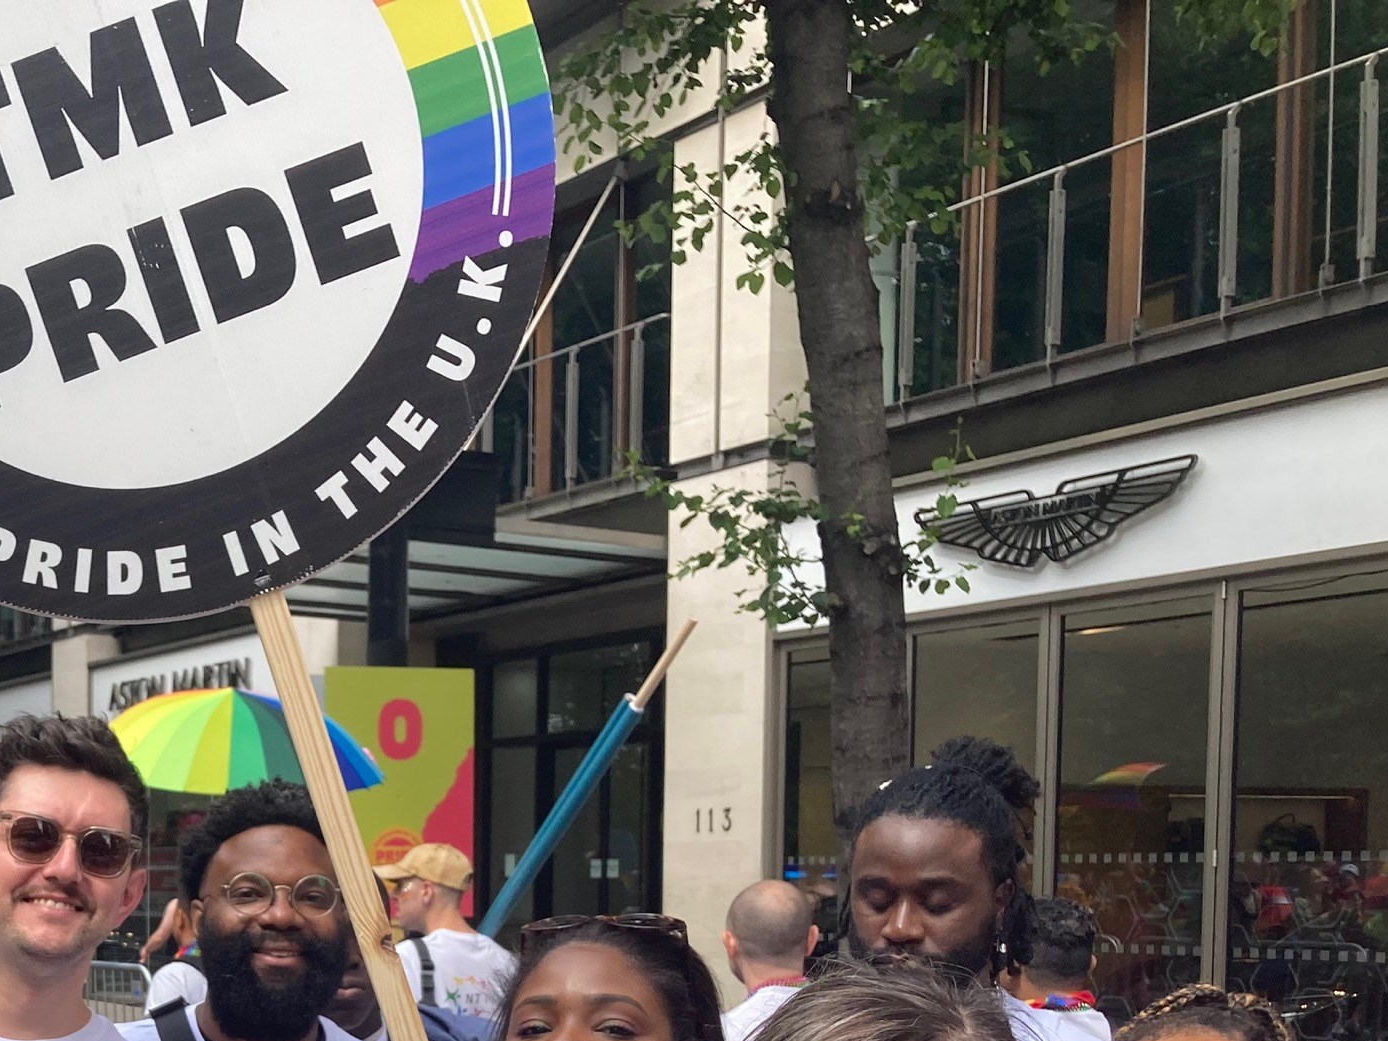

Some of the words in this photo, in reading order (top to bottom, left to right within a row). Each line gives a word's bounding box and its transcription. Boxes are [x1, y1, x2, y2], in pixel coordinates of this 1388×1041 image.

[222, 510, 301, 577] IN
[314, 400, 439, 519] THE
[425, 230, 514, 382] U.K.
[695, 807, 732, 834] 113
